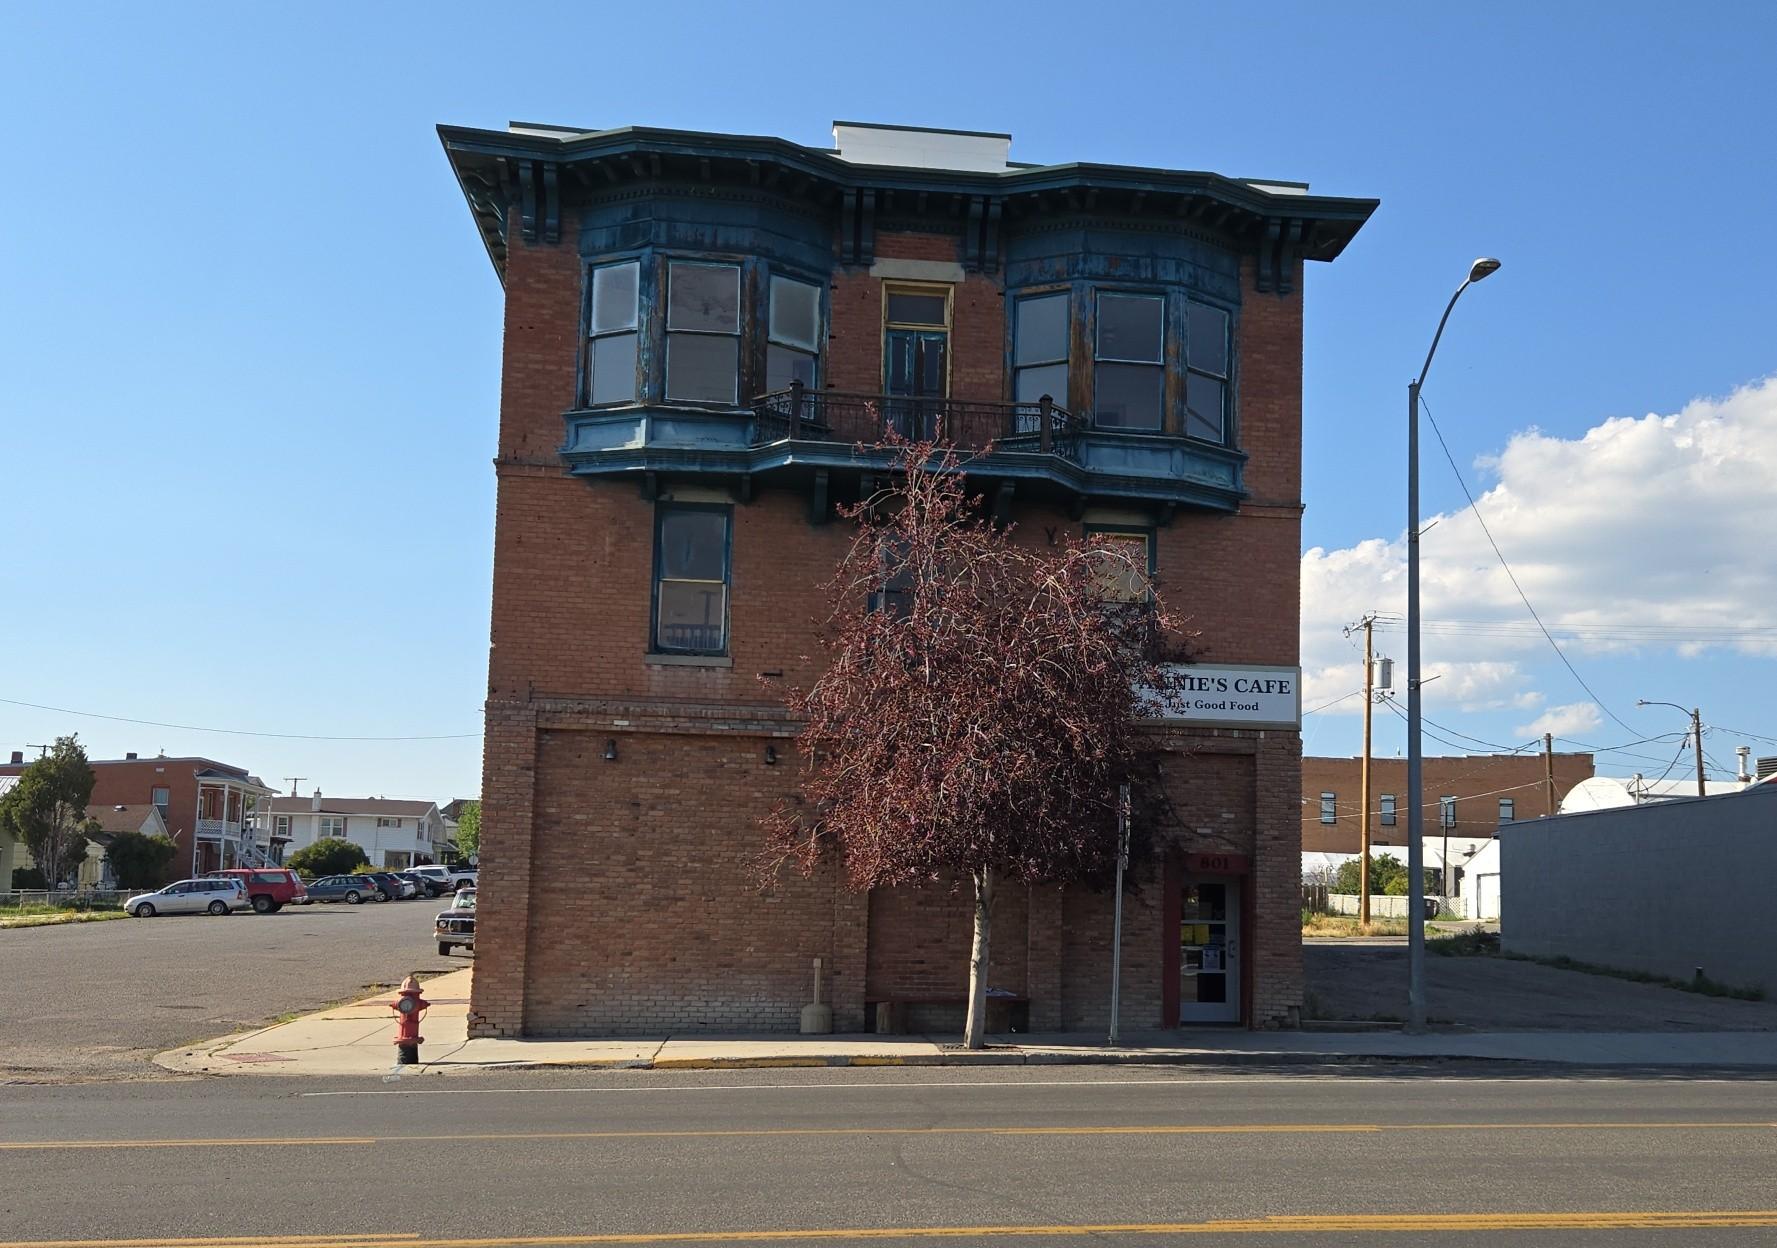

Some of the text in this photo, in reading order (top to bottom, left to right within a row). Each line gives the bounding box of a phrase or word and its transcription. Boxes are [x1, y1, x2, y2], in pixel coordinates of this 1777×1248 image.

[1138, 676, 1291, 695] NIE'S CAFE
[1194, 700, 1227, 710] Good
[1230, 701, 1259, 711] Food
[1199, 857, 1229, 869] 801
